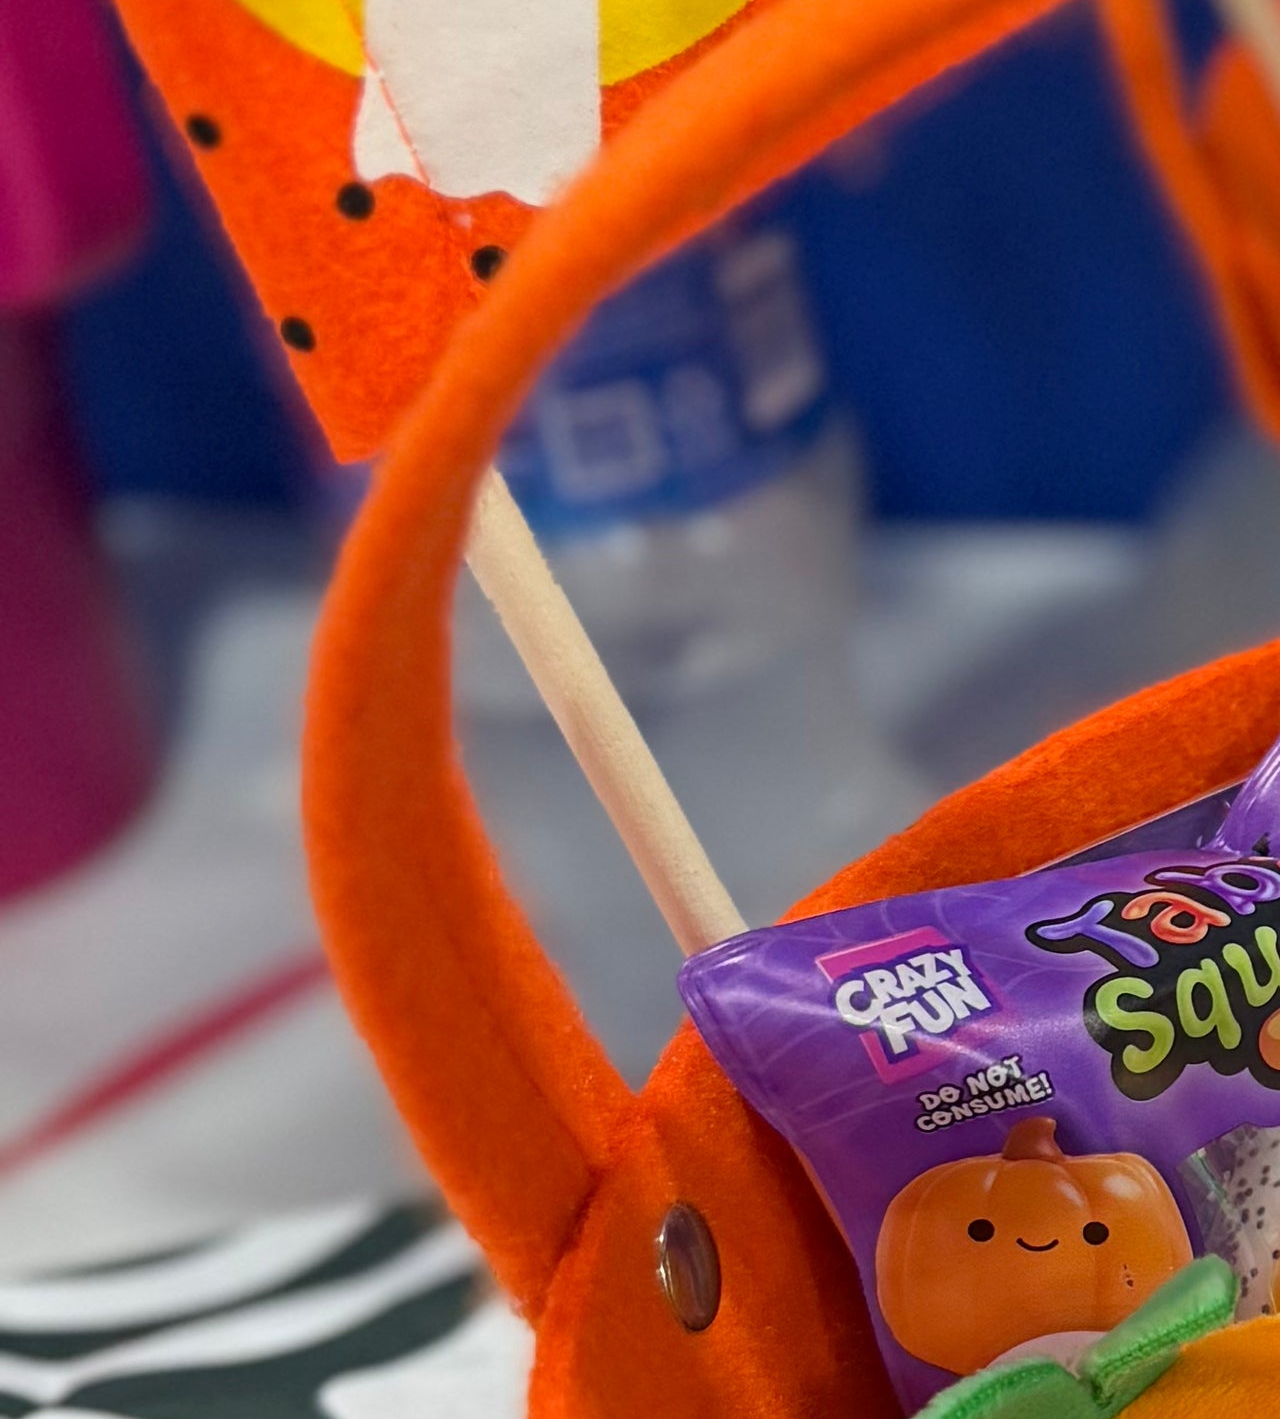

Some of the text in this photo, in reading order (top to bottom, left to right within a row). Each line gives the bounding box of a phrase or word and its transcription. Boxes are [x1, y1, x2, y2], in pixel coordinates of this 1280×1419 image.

[835, 949, 972, 1026] CRAZY
[879, 982, 993, 1055] FUN
[916, 1073, 1053, 1132] CONSUME!
[920, 1056, 1022, 1110] DO NOT
